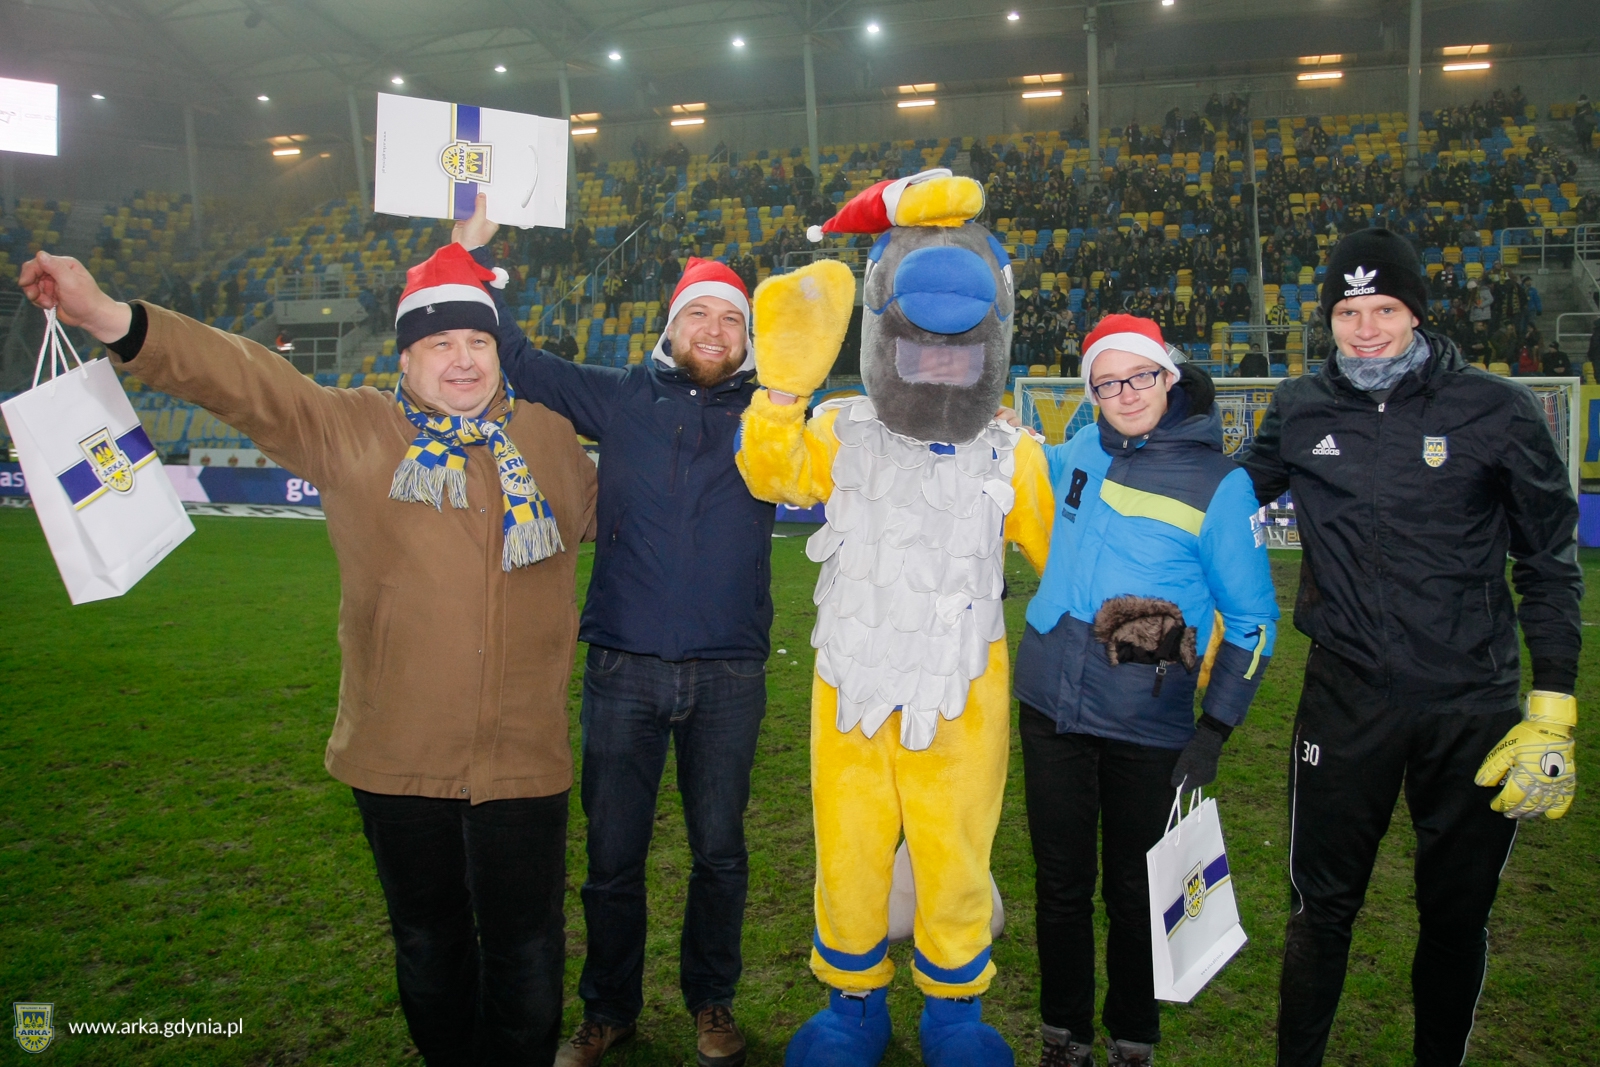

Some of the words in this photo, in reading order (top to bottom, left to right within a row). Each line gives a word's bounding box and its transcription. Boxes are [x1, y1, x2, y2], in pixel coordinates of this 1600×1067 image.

[1344, 285, 1376, 297] adidas
[1312, 447, 1340, 456] adidas
[103, 460, 125, 477] ARKA
[1301, 740, 1320, 766] 30
